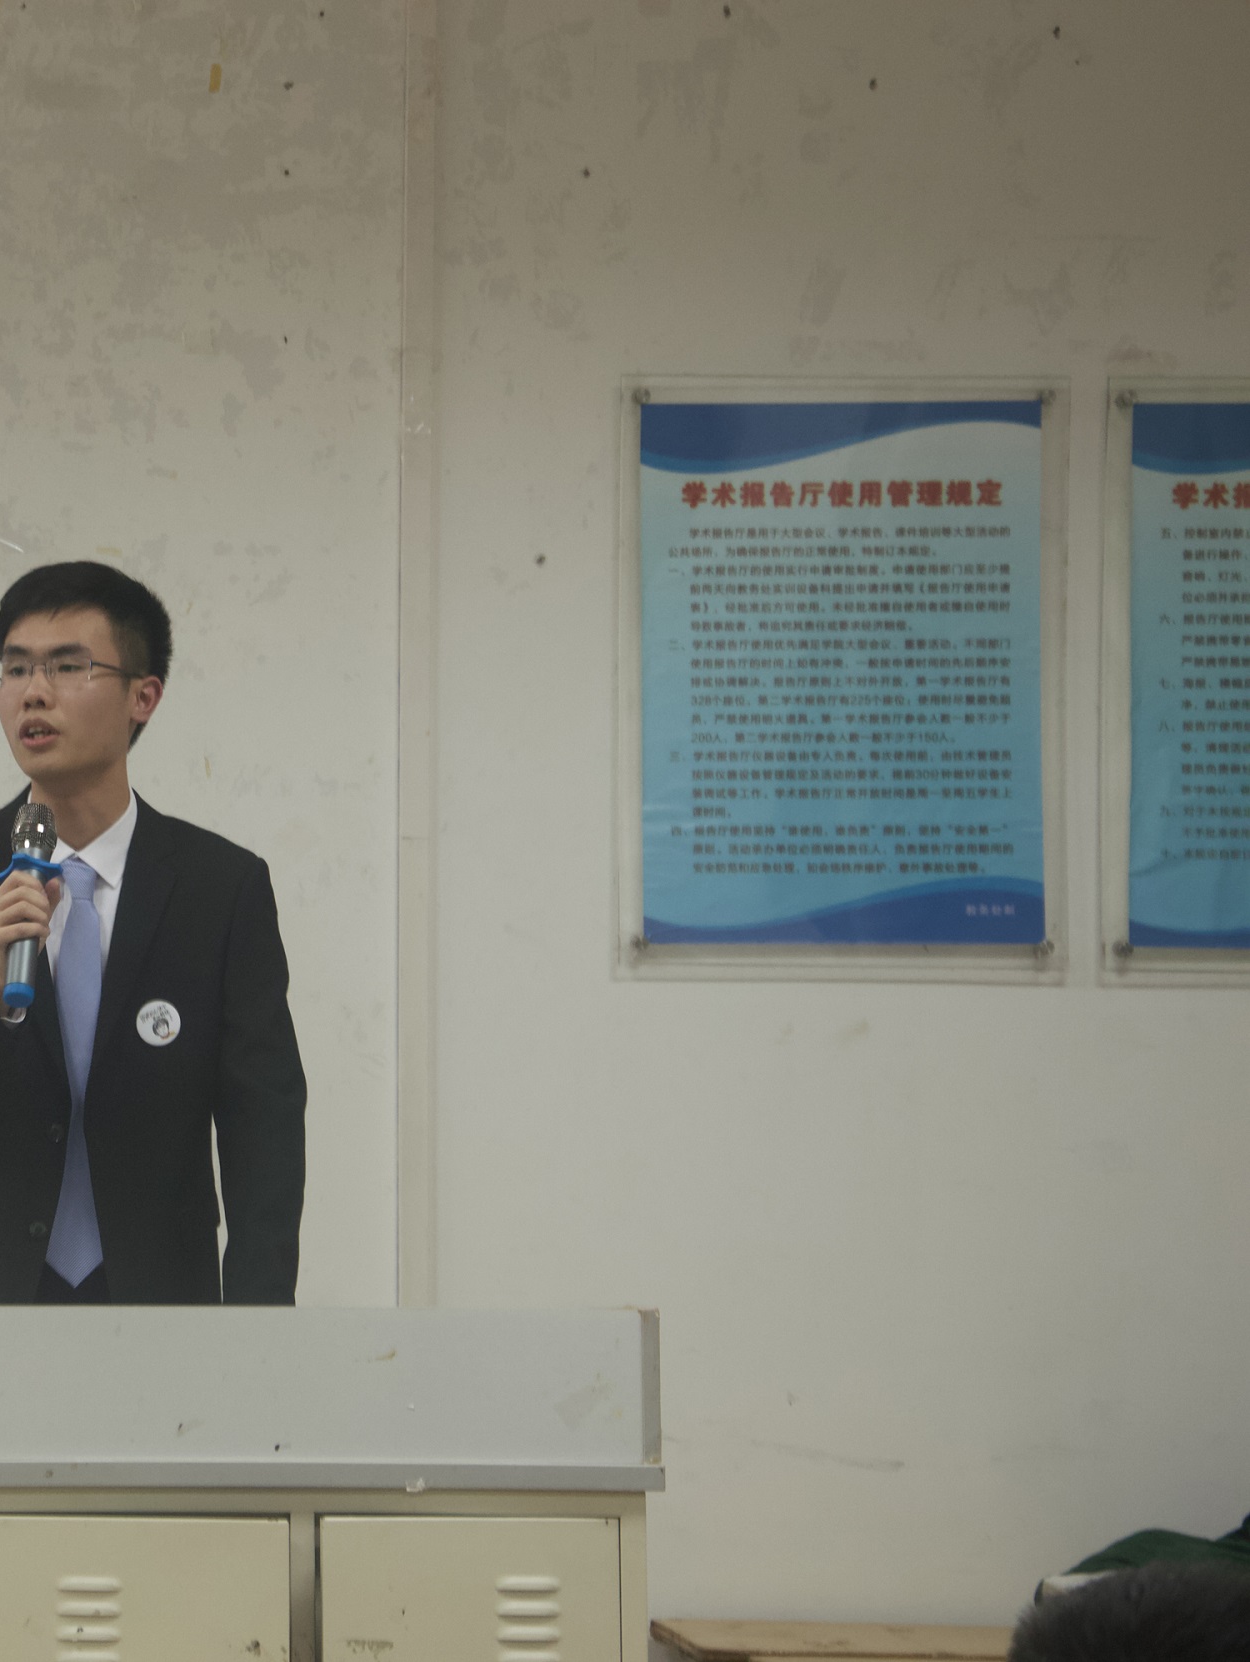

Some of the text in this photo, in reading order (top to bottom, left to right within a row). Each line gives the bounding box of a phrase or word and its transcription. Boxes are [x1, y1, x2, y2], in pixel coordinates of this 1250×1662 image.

[681, 478, 1004, 509] 学术报告厅使用管理规定
